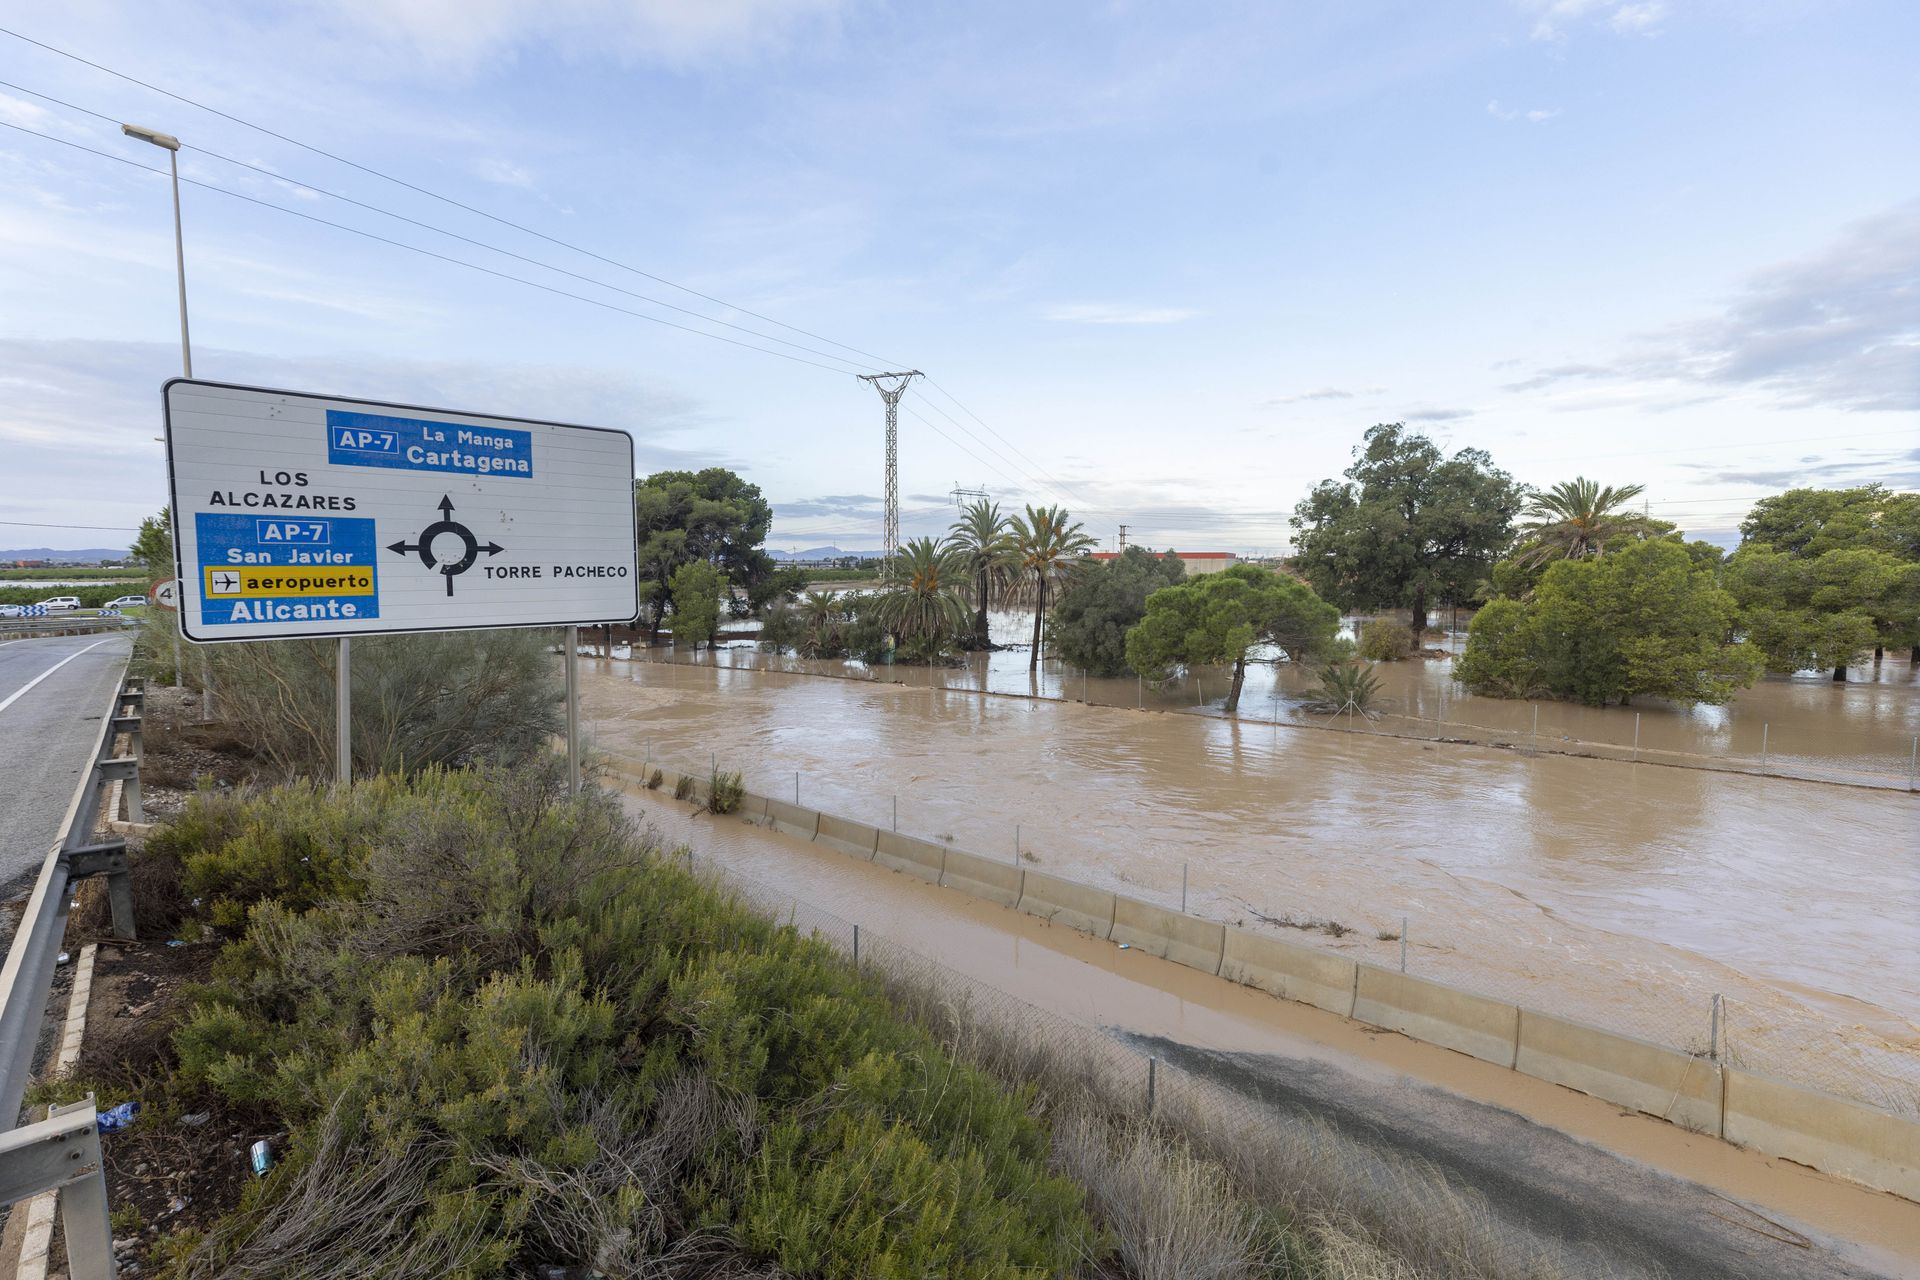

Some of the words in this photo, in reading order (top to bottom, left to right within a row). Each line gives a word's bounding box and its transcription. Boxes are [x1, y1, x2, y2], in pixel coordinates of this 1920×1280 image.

[339, 430, 394, 451] AP-7
[423, 427, 444, 442] La
[457, 430, 514, 450] Manga
[406, 446, 530, 473] Cartagena
[260, 470, 309, 487] LOS
[209, 491, 357, 511] ALCAZARES
[264, 523, 323, 541] AP-7
[227, 548, 271, 564] San
[288, 548, 353, 564] Javier
[484, 566, 542, 579] TORRE
[553, 565, 628, 578] PACHECO
[247, 574, 369, 592] aeropuerto
[230, 600, 357, 621] Alicante
